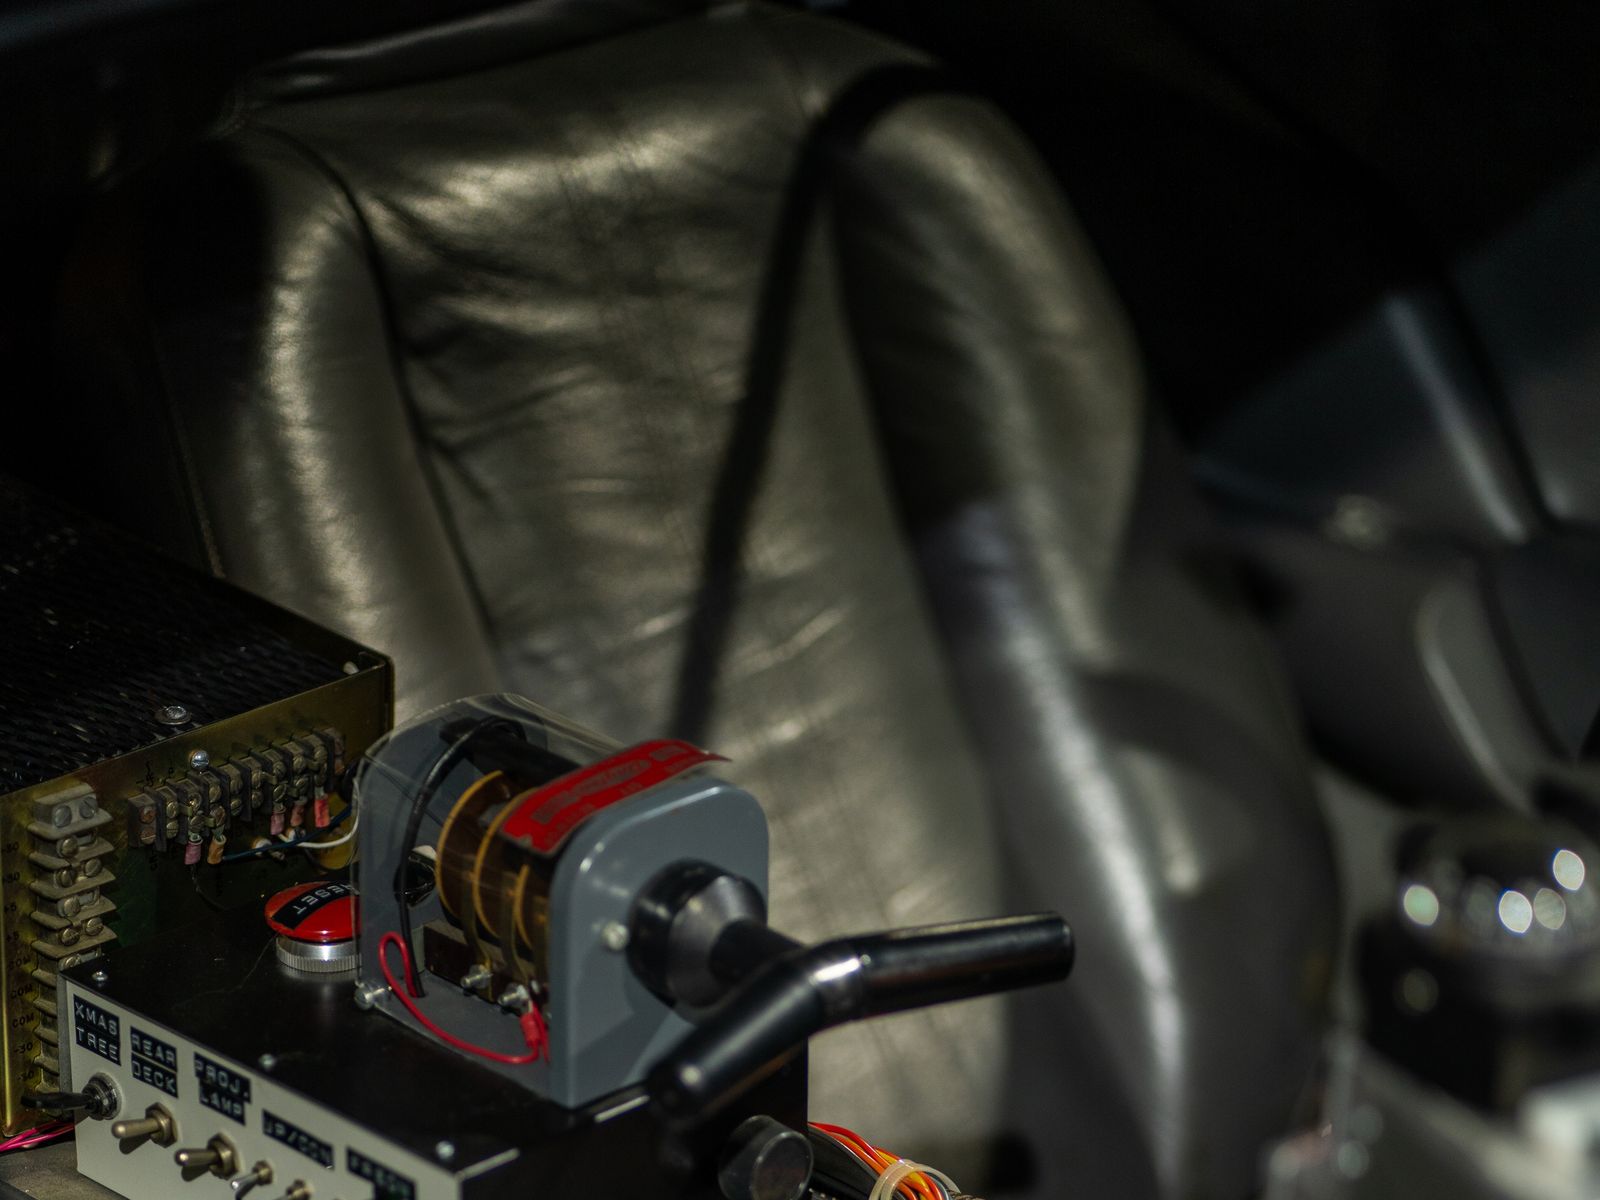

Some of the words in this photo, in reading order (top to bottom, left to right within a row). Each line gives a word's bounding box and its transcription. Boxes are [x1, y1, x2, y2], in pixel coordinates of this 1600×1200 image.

[12, 1013, 34, 1028] COM
[75, 1001, 118, 1035] XMAS
[76, 1026, 119, 1061] TREE
[131, 1032, 176, 1063] REAR
[132, 1059, 177, 1094] DECK
[201, 1089, 244, 1117] LAMP
